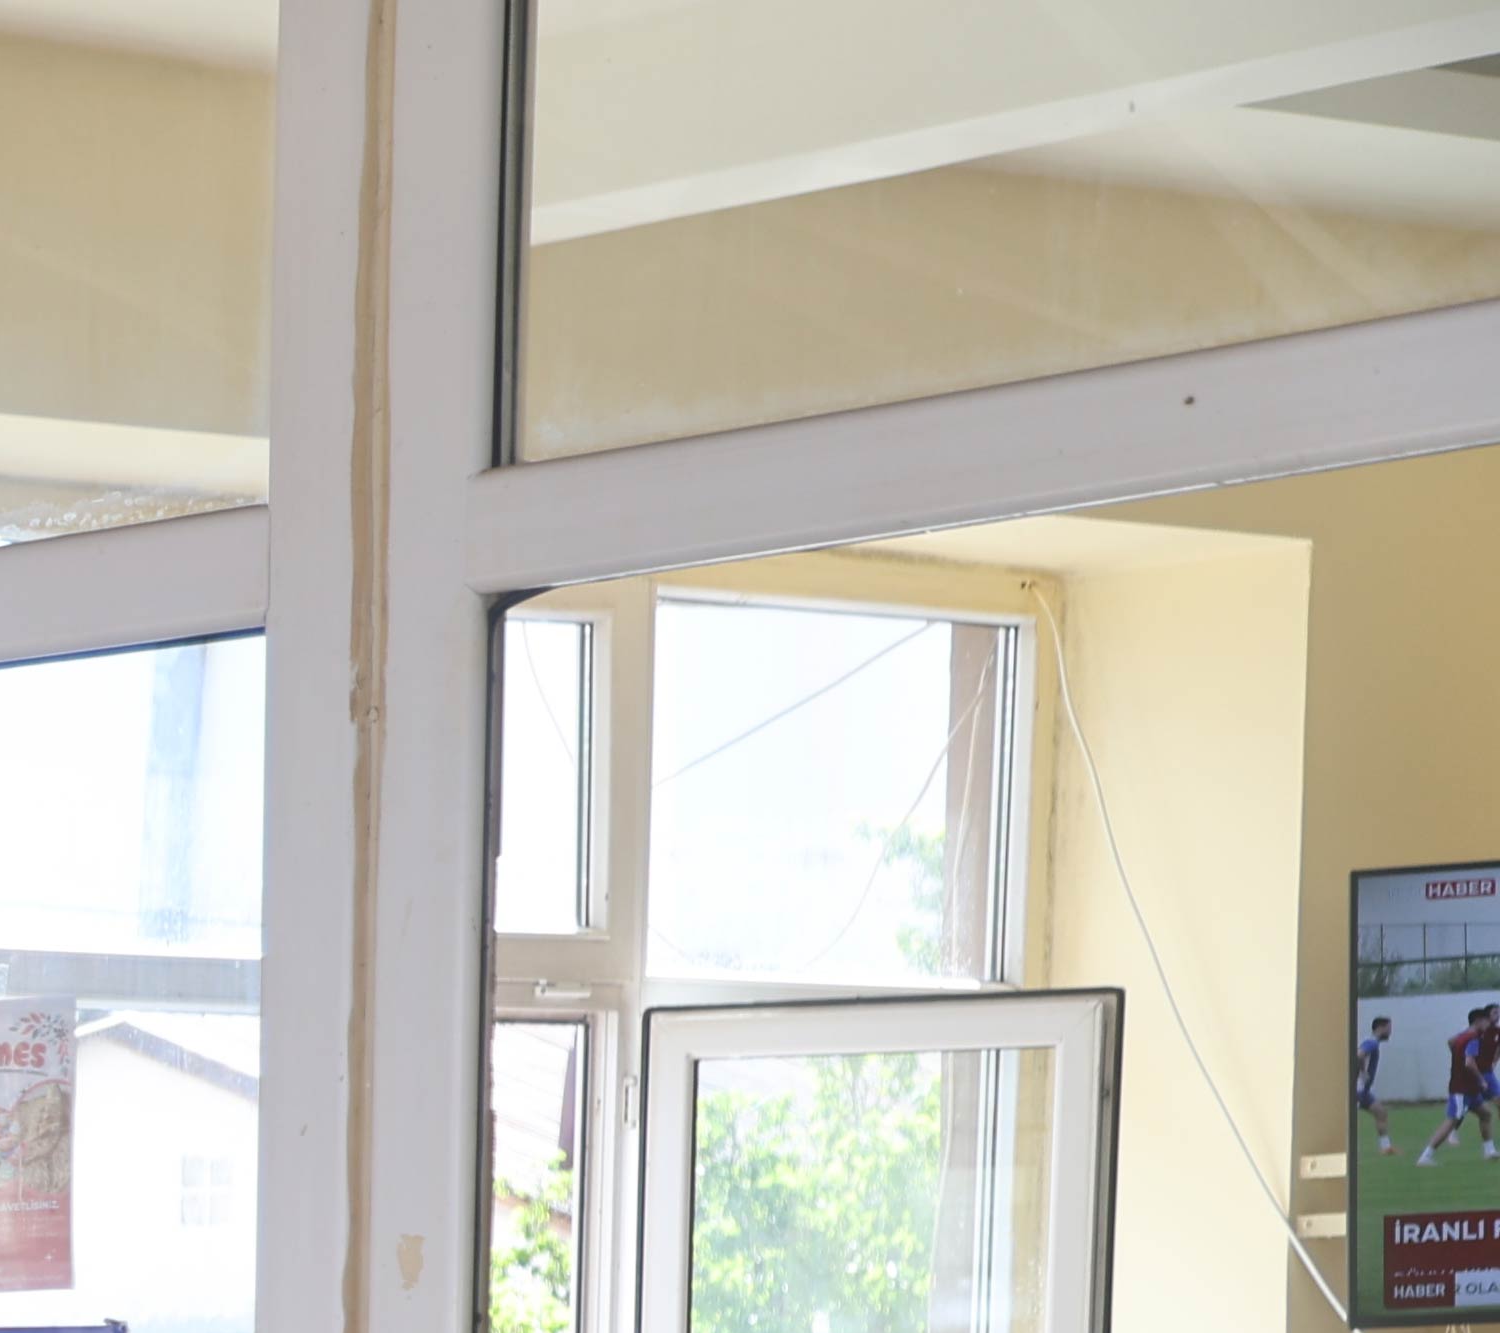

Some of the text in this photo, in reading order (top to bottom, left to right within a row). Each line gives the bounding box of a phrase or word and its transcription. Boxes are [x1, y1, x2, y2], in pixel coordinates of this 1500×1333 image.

[1428, 881, 1492, 897] HABER
[1394, 1219, 1485, 1244] İRANLI
[1394, 1283, 1445, 1299] HABER
